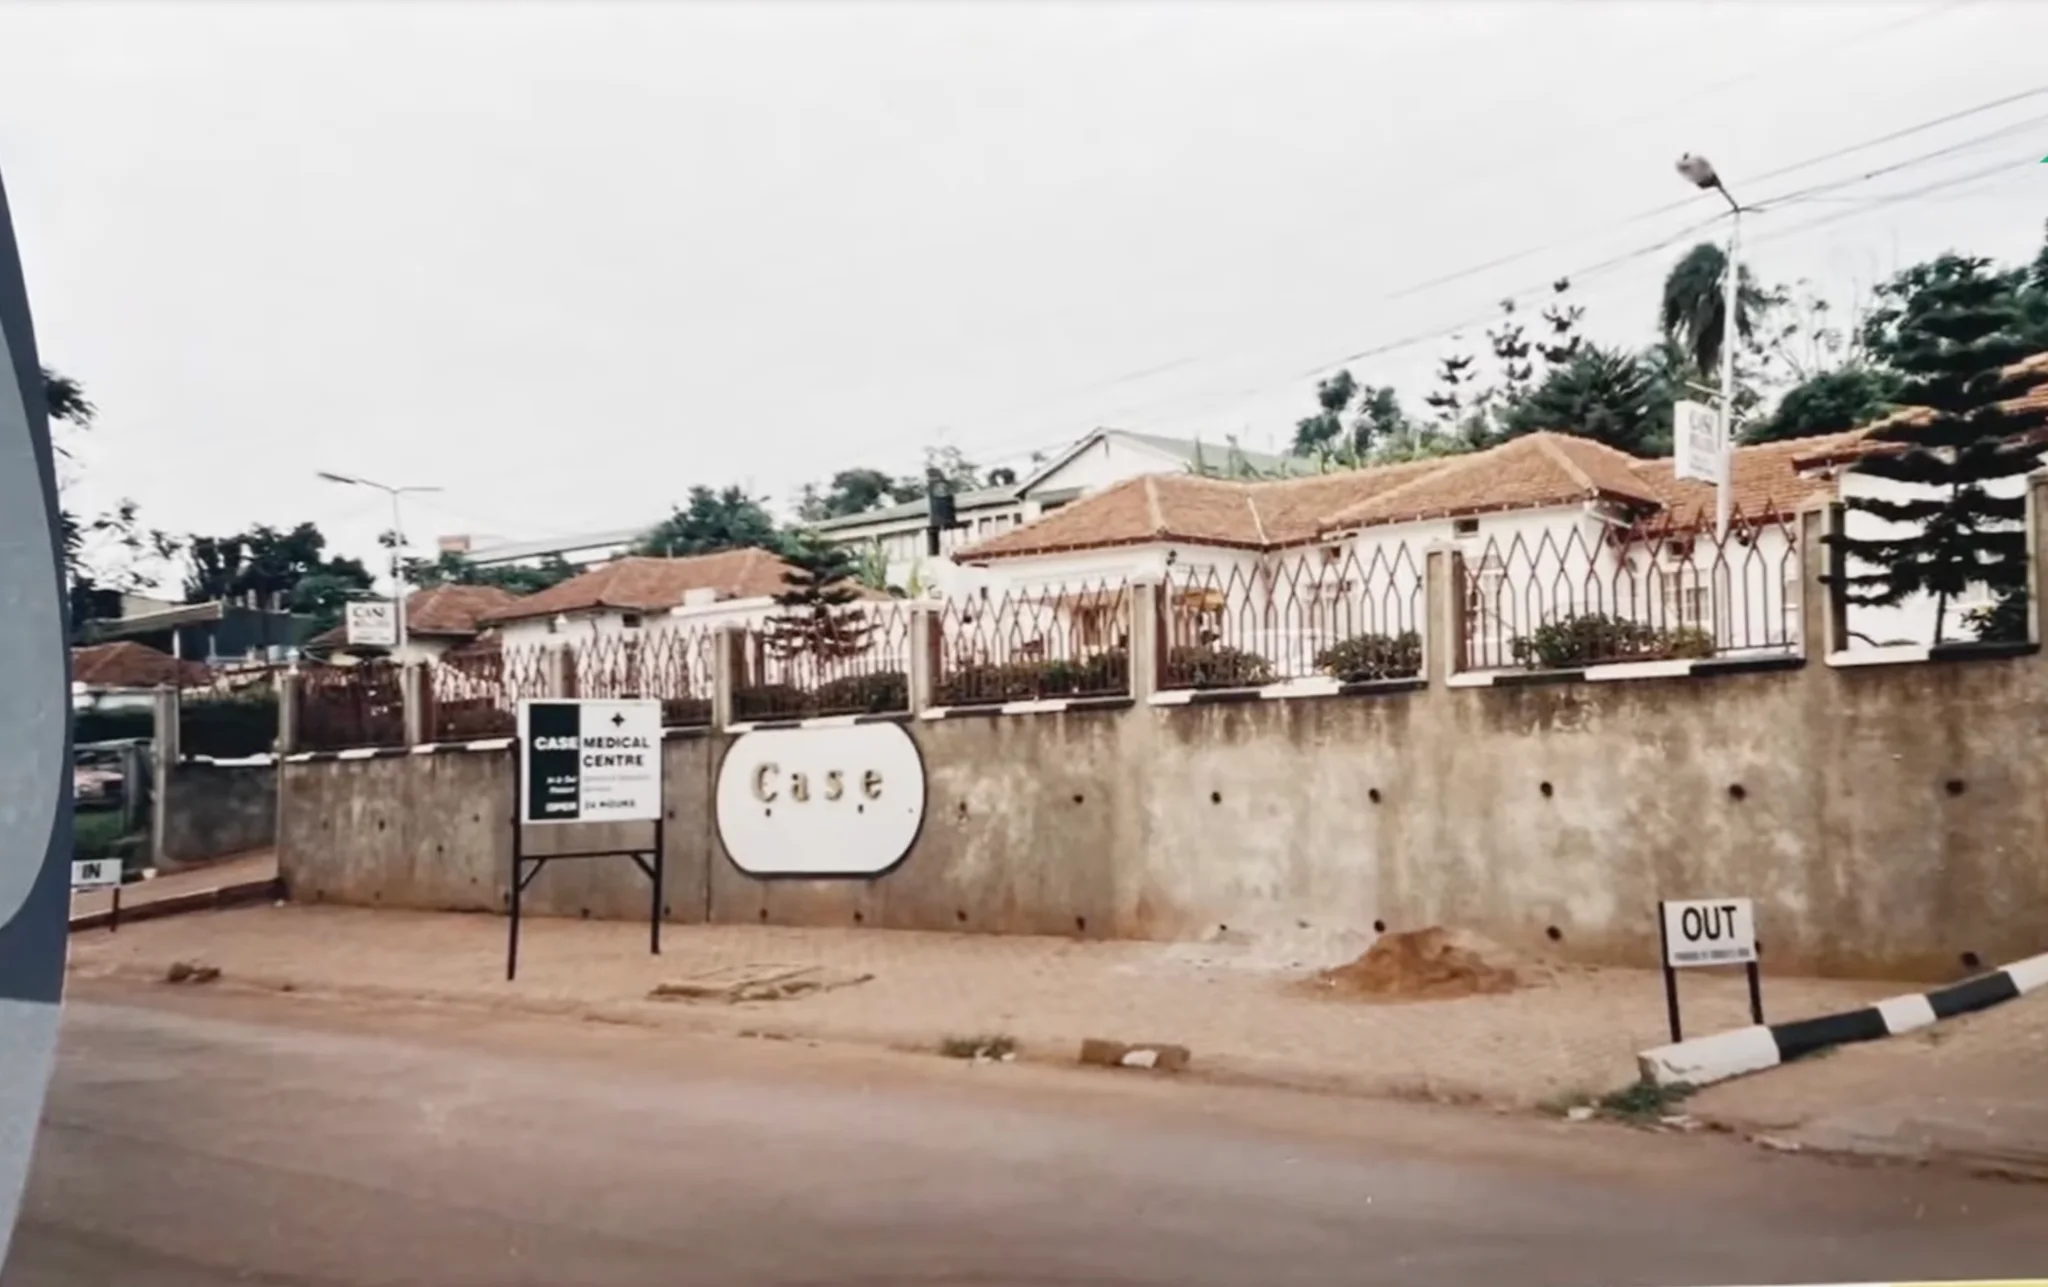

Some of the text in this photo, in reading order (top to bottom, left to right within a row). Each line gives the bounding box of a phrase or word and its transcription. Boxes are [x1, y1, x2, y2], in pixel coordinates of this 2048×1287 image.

[534, 736, 650, 750] CASE MEDICAL
[583, 754, 643, 767] CENTRE
[752, 762, 883, 803] Case
[82, 862, 101, 879] IN
[1682, 905, 1737, 942] OUT
